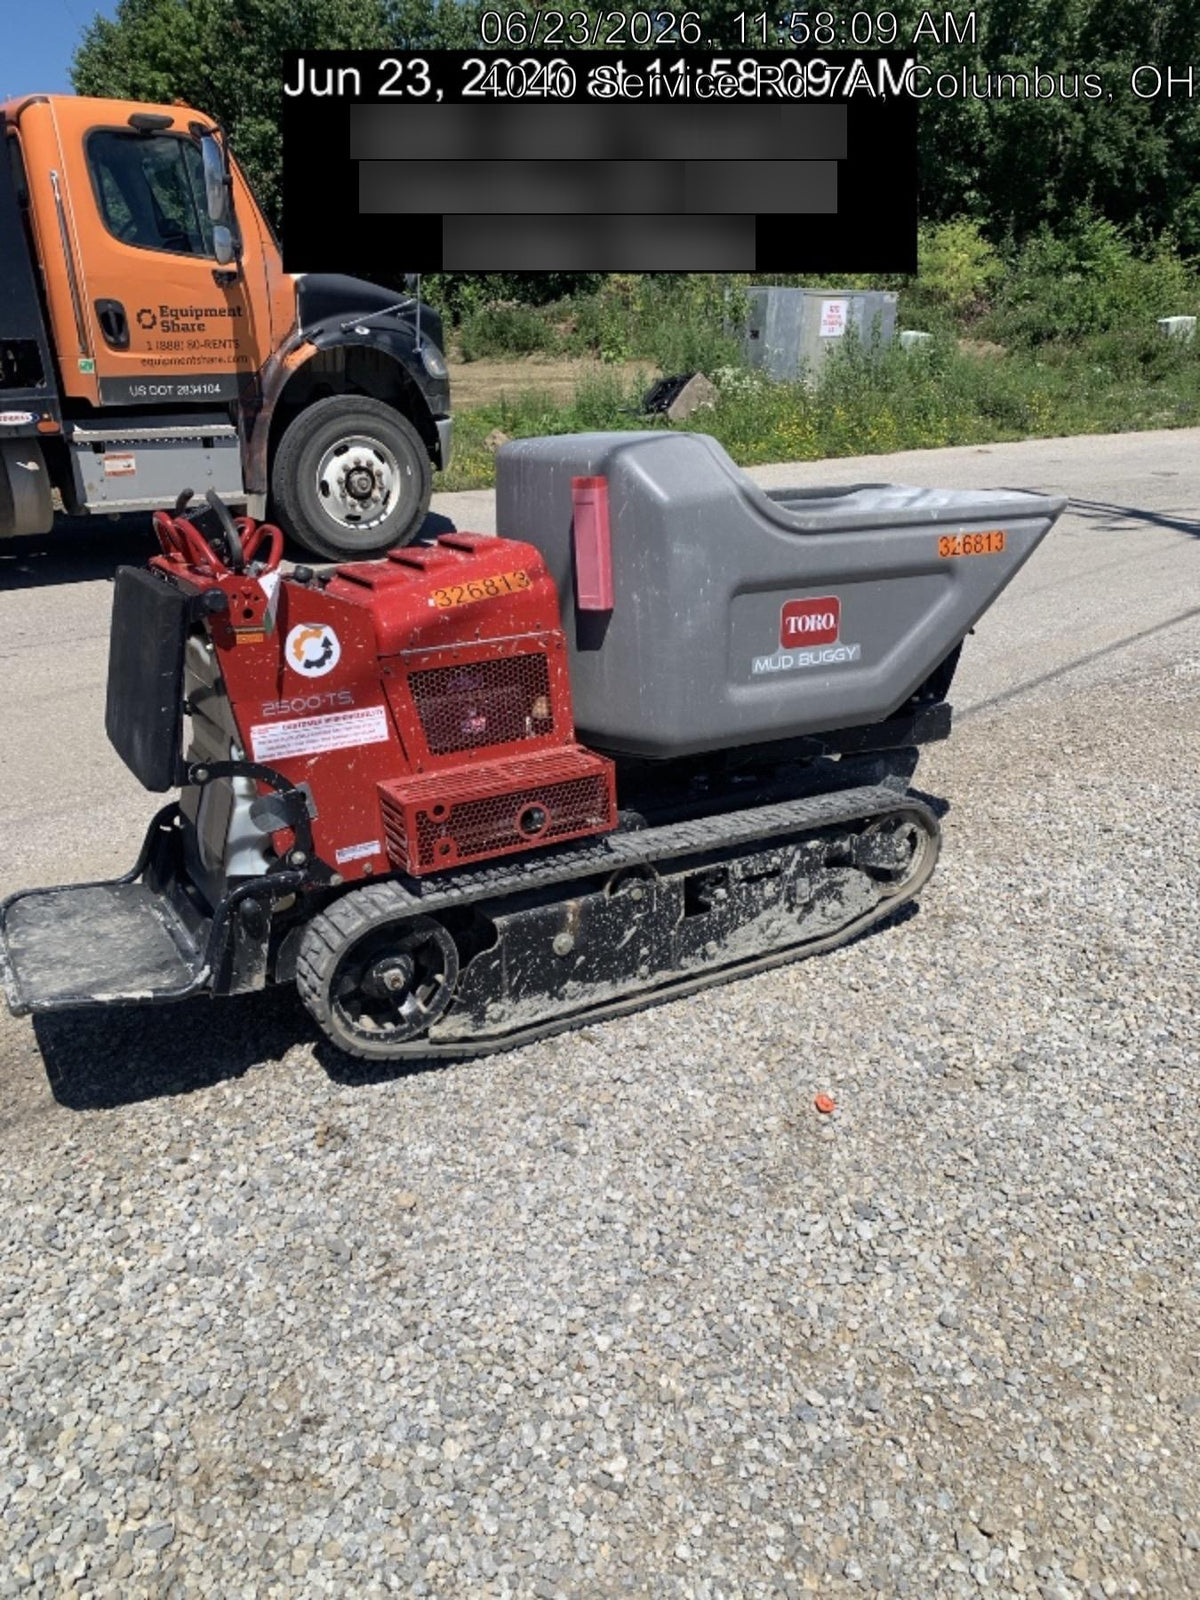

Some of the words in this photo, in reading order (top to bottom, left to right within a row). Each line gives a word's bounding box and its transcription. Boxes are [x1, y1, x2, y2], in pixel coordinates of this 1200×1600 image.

[159, 305, 243, 320] Equipment
[161, 320, 206, 333] Share
[146, 341, 153, 351] 1
[141, 354, 248, 368] equipmentshare.com
[129, 385, 147, 397] US
[148, 384, 174, 396] DOT
[939, 531, 1004, 557] 326813
[434, 571, 530, 607] 326813
[786, 612, 835, 634] TORO
[754, 655, 793, 672] MUD
[798, 646, 857, 666] BUGGY
